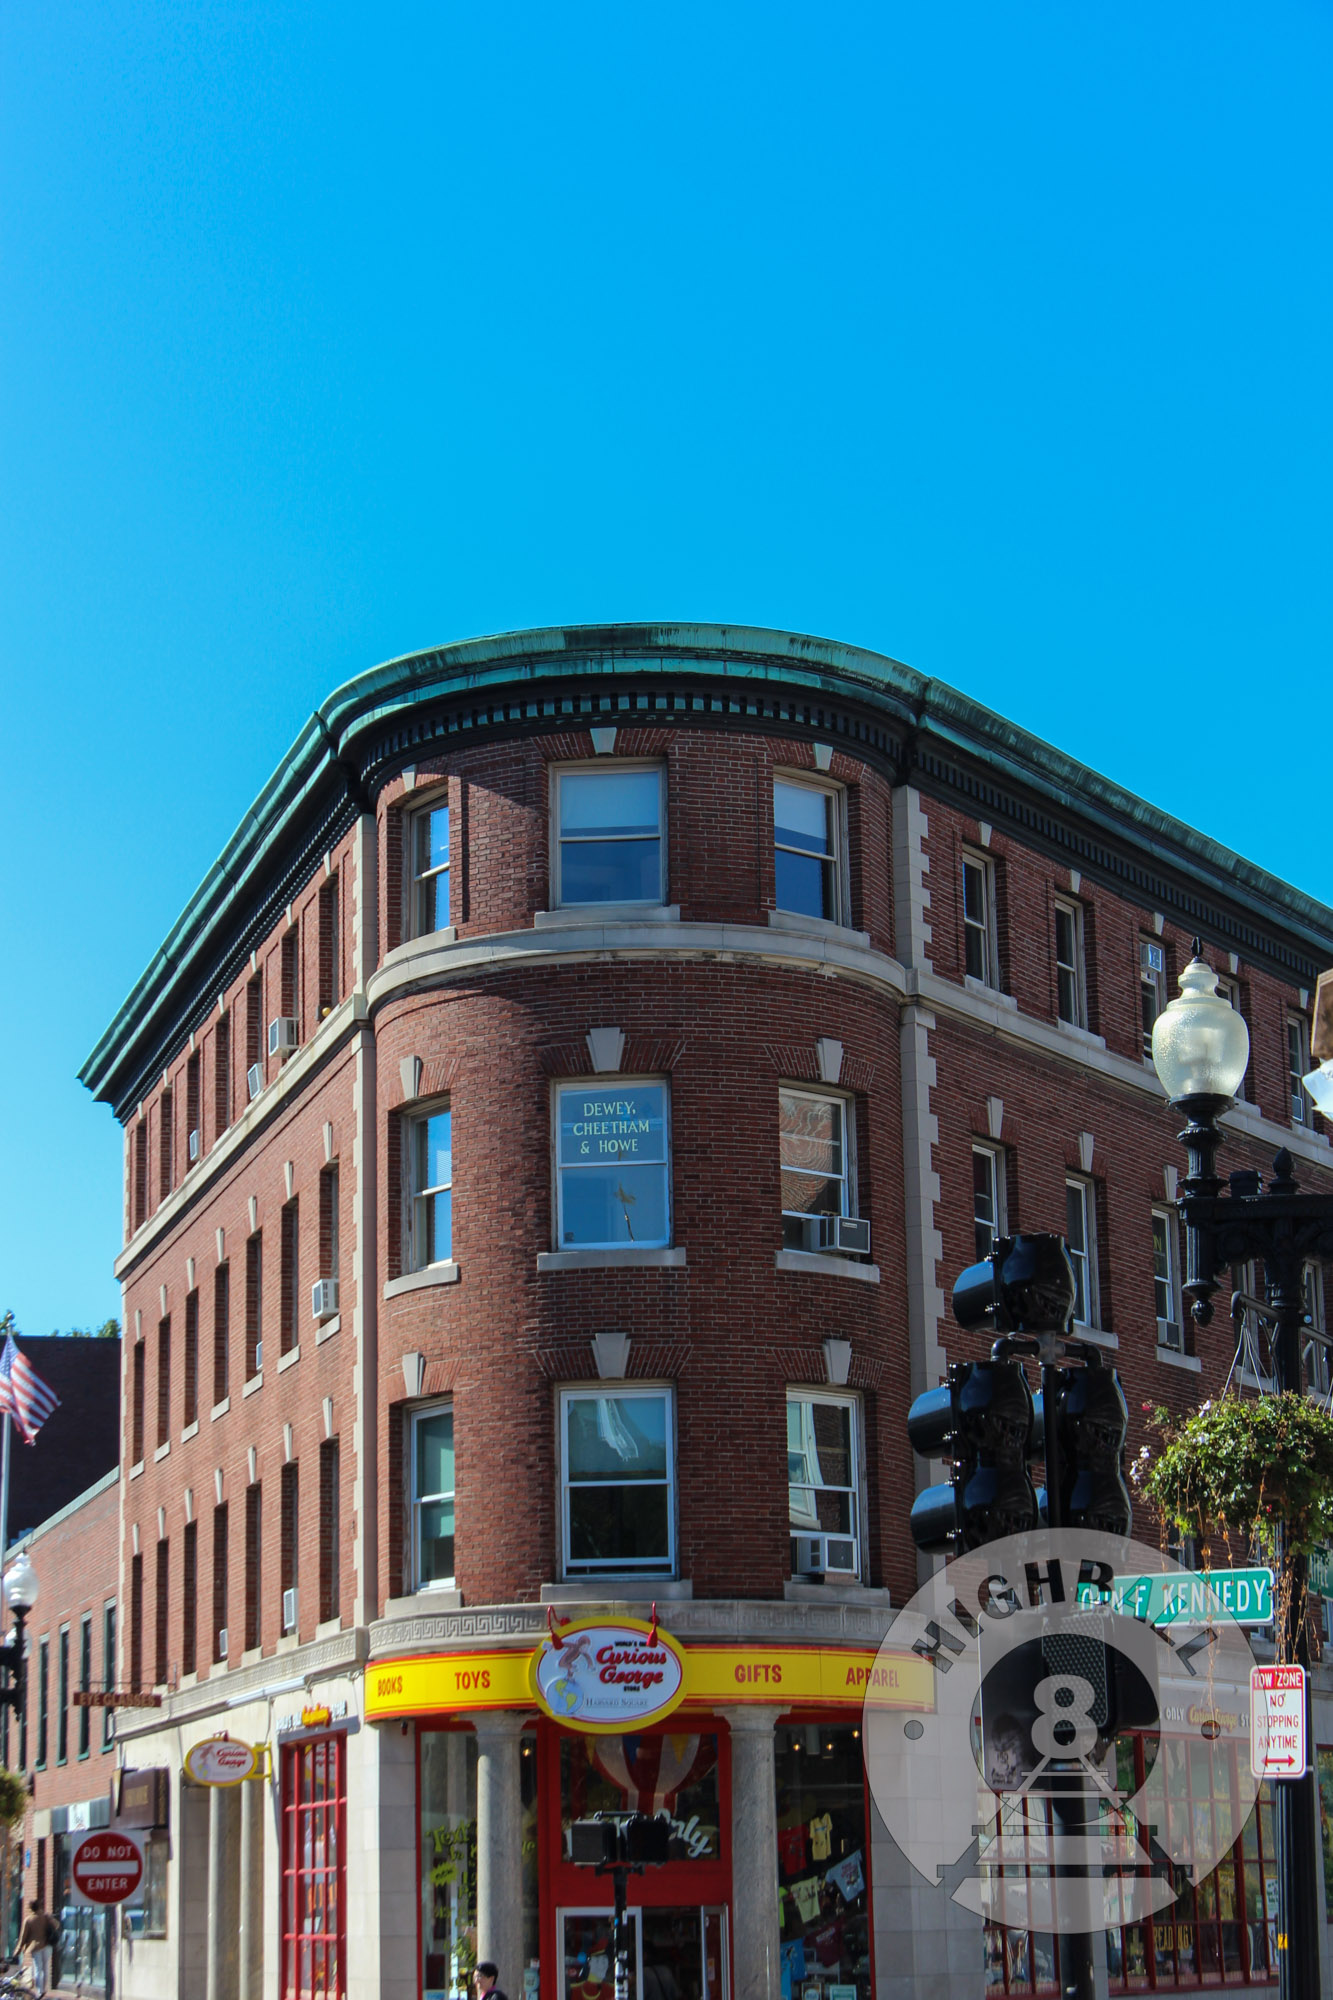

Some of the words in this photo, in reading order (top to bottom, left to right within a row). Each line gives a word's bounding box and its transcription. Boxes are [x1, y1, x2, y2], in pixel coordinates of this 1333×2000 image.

[583, 1101, 636, 1117] DEWEY,
[572, 1119, 650, 1136] CHEETHAM
[580, 1140, 590, 1154] &
[599, 1138, 639, 1153] HOWE
[1162, 1579, 1267, 1615] KENNEDY
[596, 1645, 667, 1664] Curious
[454, 1670, 491, 1690] TOYS
[599, 1664, 664, 1689] George
[734, 1664, 782, 1683] GIFTS
[846, 1667, 899, 1688] APPAREL
[1253, 1673, 1274, 1688] TOW
[1276, 1672, 1302, 1688] ZONE
[377, 1675, 403, 1697] BOOKS
[1269, 1694, 1286, 1708] NO
[1257, 1714, 1299, 1729] STOPPING
[1258, 1734, 1298, 1750] ANYTIME
[83, 1846, 101, 1858] DO
[107, 1845, 132, 1858] NOT
[87, 1877, 128, 1890] ENTER
[1153, 1924, 1193, 1951] READNG!
